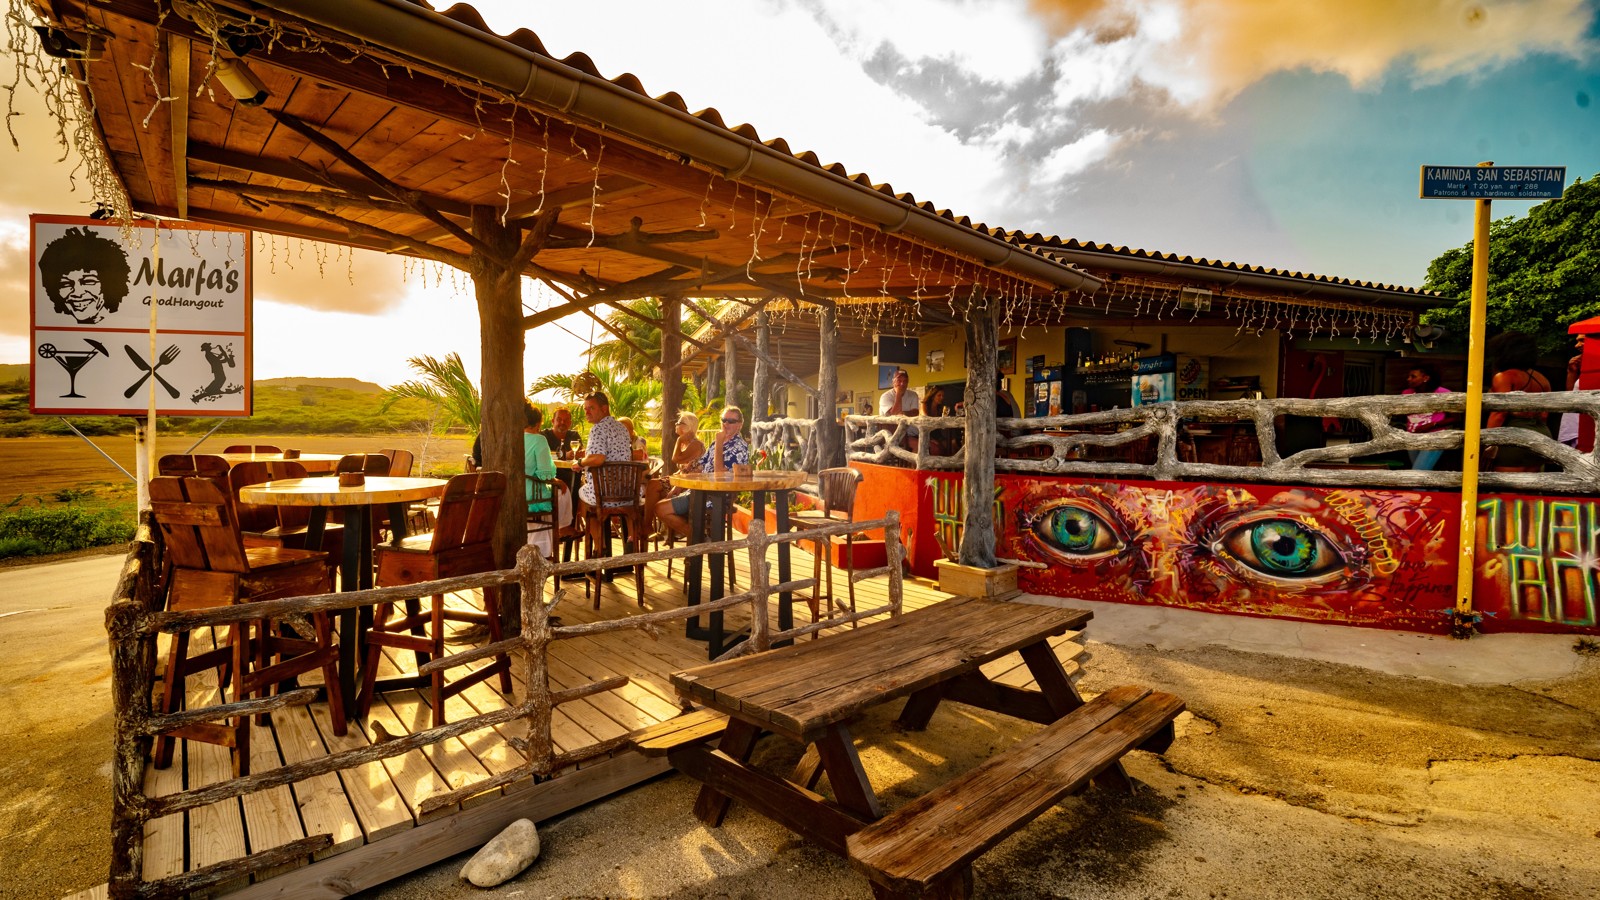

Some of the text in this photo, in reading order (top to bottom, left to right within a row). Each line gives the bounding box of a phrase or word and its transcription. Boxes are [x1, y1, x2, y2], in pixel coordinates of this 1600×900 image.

[1427, 168, 1562, 182] KAMINDA SAN SEBASTIAN
[132, 256, 239, 296] Marfa's
[142, 295, 224, 310] GodHangout
[1179, 387, 1206, 399] OPEN
